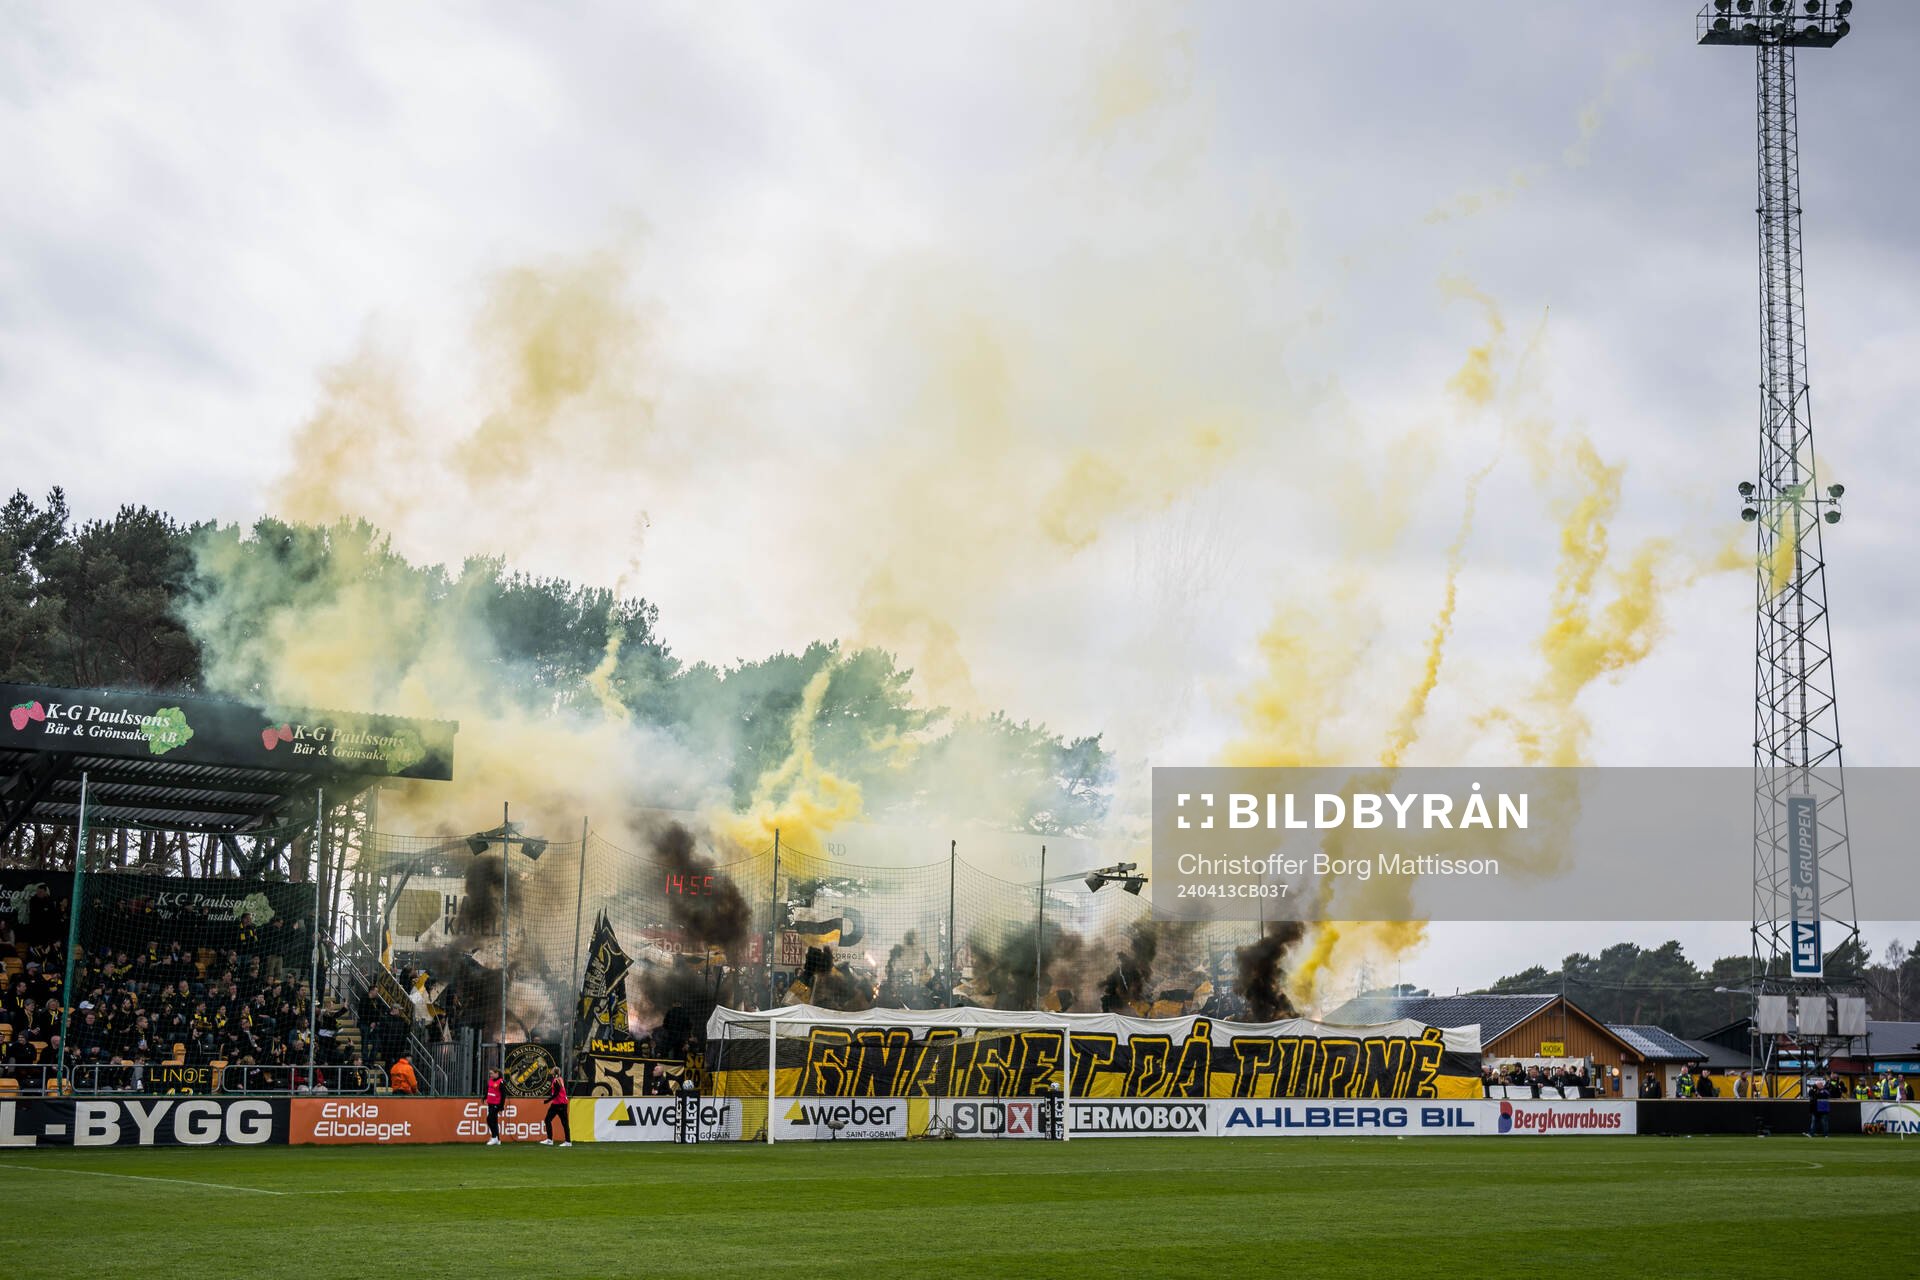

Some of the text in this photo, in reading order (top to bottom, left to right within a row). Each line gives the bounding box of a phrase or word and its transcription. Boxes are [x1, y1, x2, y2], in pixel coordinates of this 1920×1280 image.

[46, 703, 171, 728] K-G Paulssons
[45, 721, 178, 743] Bär & Grönsaker AB
[293, 724, 405, 747] K-G Paulssons
[293, 742, 315, 755] Bär
[318, 745, 328, 757] &
[332, 745, 390, 761] Grönsaker
[1798, 805, 1813, 884] GRUPPEN
[1797, 886, 1816, 967] LEVINS
[1543, 1044, 1562, 1054] KIOSK
[1230, 1026, 1446, 1098] TURNÉ
[321, 1102, 379, 1118] Enkla
[636, 1105, 730, 1127] weer
[685, 1096, 698, 1144] SELECT
[809, 1099, 897, 1126] weber
[956, 1105, 1033, 1133] SDX
[1041, 1106, 1205, 1131] ERMOBOX
[1225, 1107, 1475, 1128] AHLBERG BIL
[1514, 1108, 1621, 1133] Bergkvarabuss
[0, 1100, 273, 1147] L-BYGG
[314, 1120, 411, 1141] Elbolaget
[456, 1120, 548, 1140] Elblaget
[846, 1130, 897, 1138] SAINT-GOBAIN
